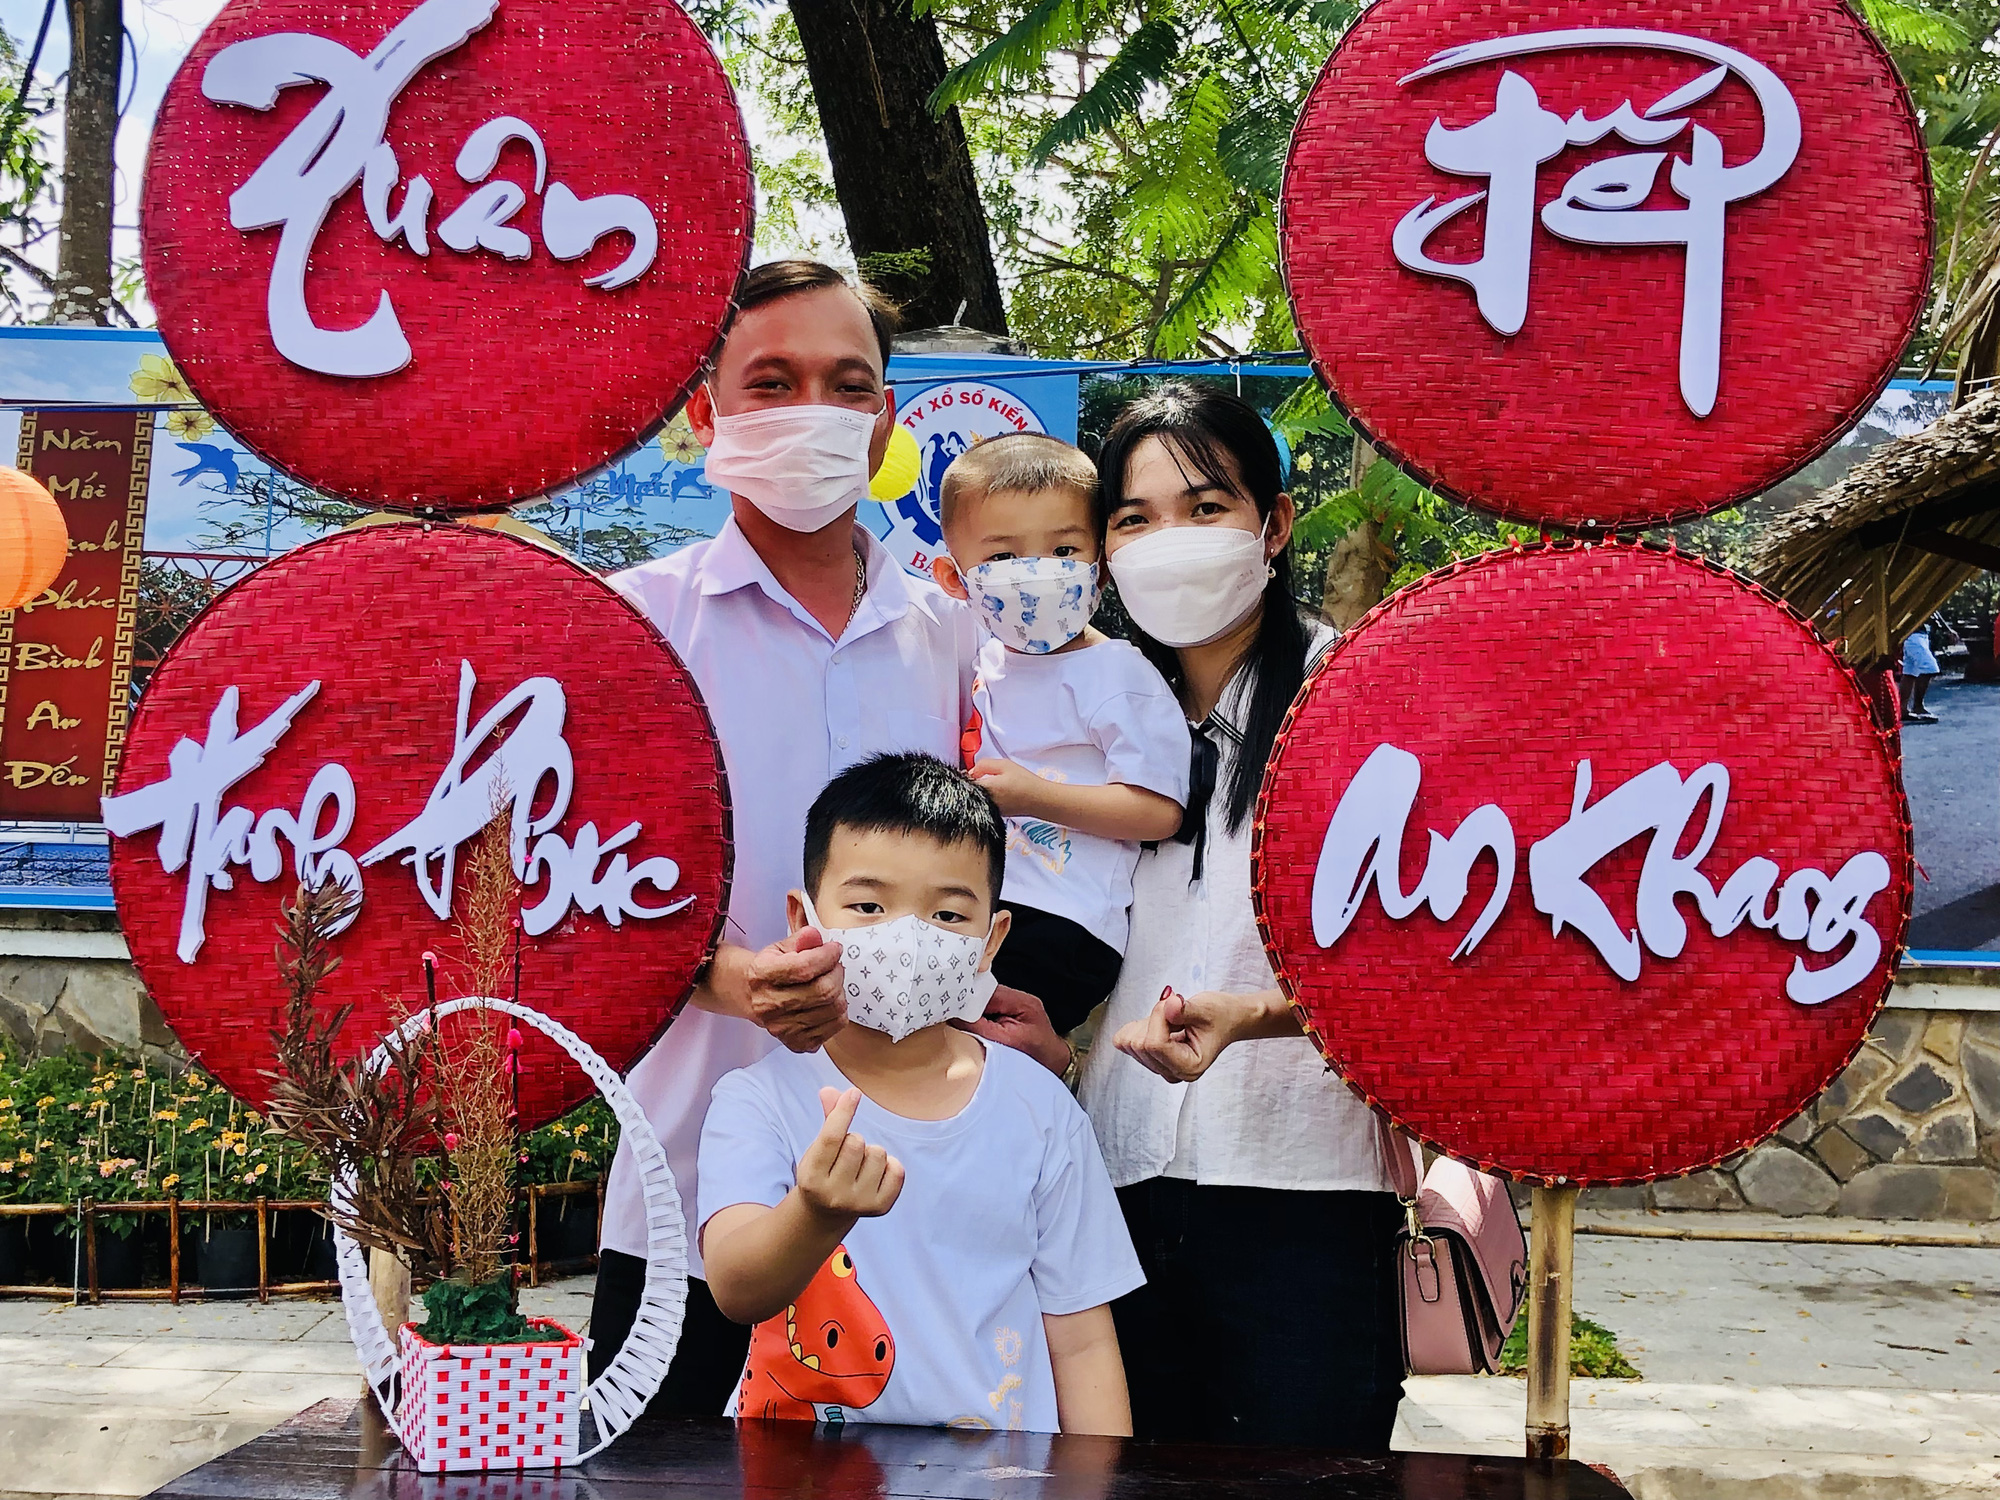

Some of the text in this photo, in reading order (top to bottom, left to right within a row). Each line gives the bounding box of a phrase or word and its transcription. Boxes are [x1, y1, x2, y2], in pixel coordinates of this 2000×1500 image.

[201, 0, 659, 377] Xuân
[902, 387, 1029, 431] TY XỔ SỐ KIẾN
[41, 428, 122, 455] Năm
[22, 579, 116, 614] Phúc
[14, 636, 105, 671] Bình
[26, 700, 82, 731] An
[3, 755, 91, 790] Đến
[101, 658, 697, 964] Hạnh Phúc
[1311, 742, 1891, 1005] An Khang
